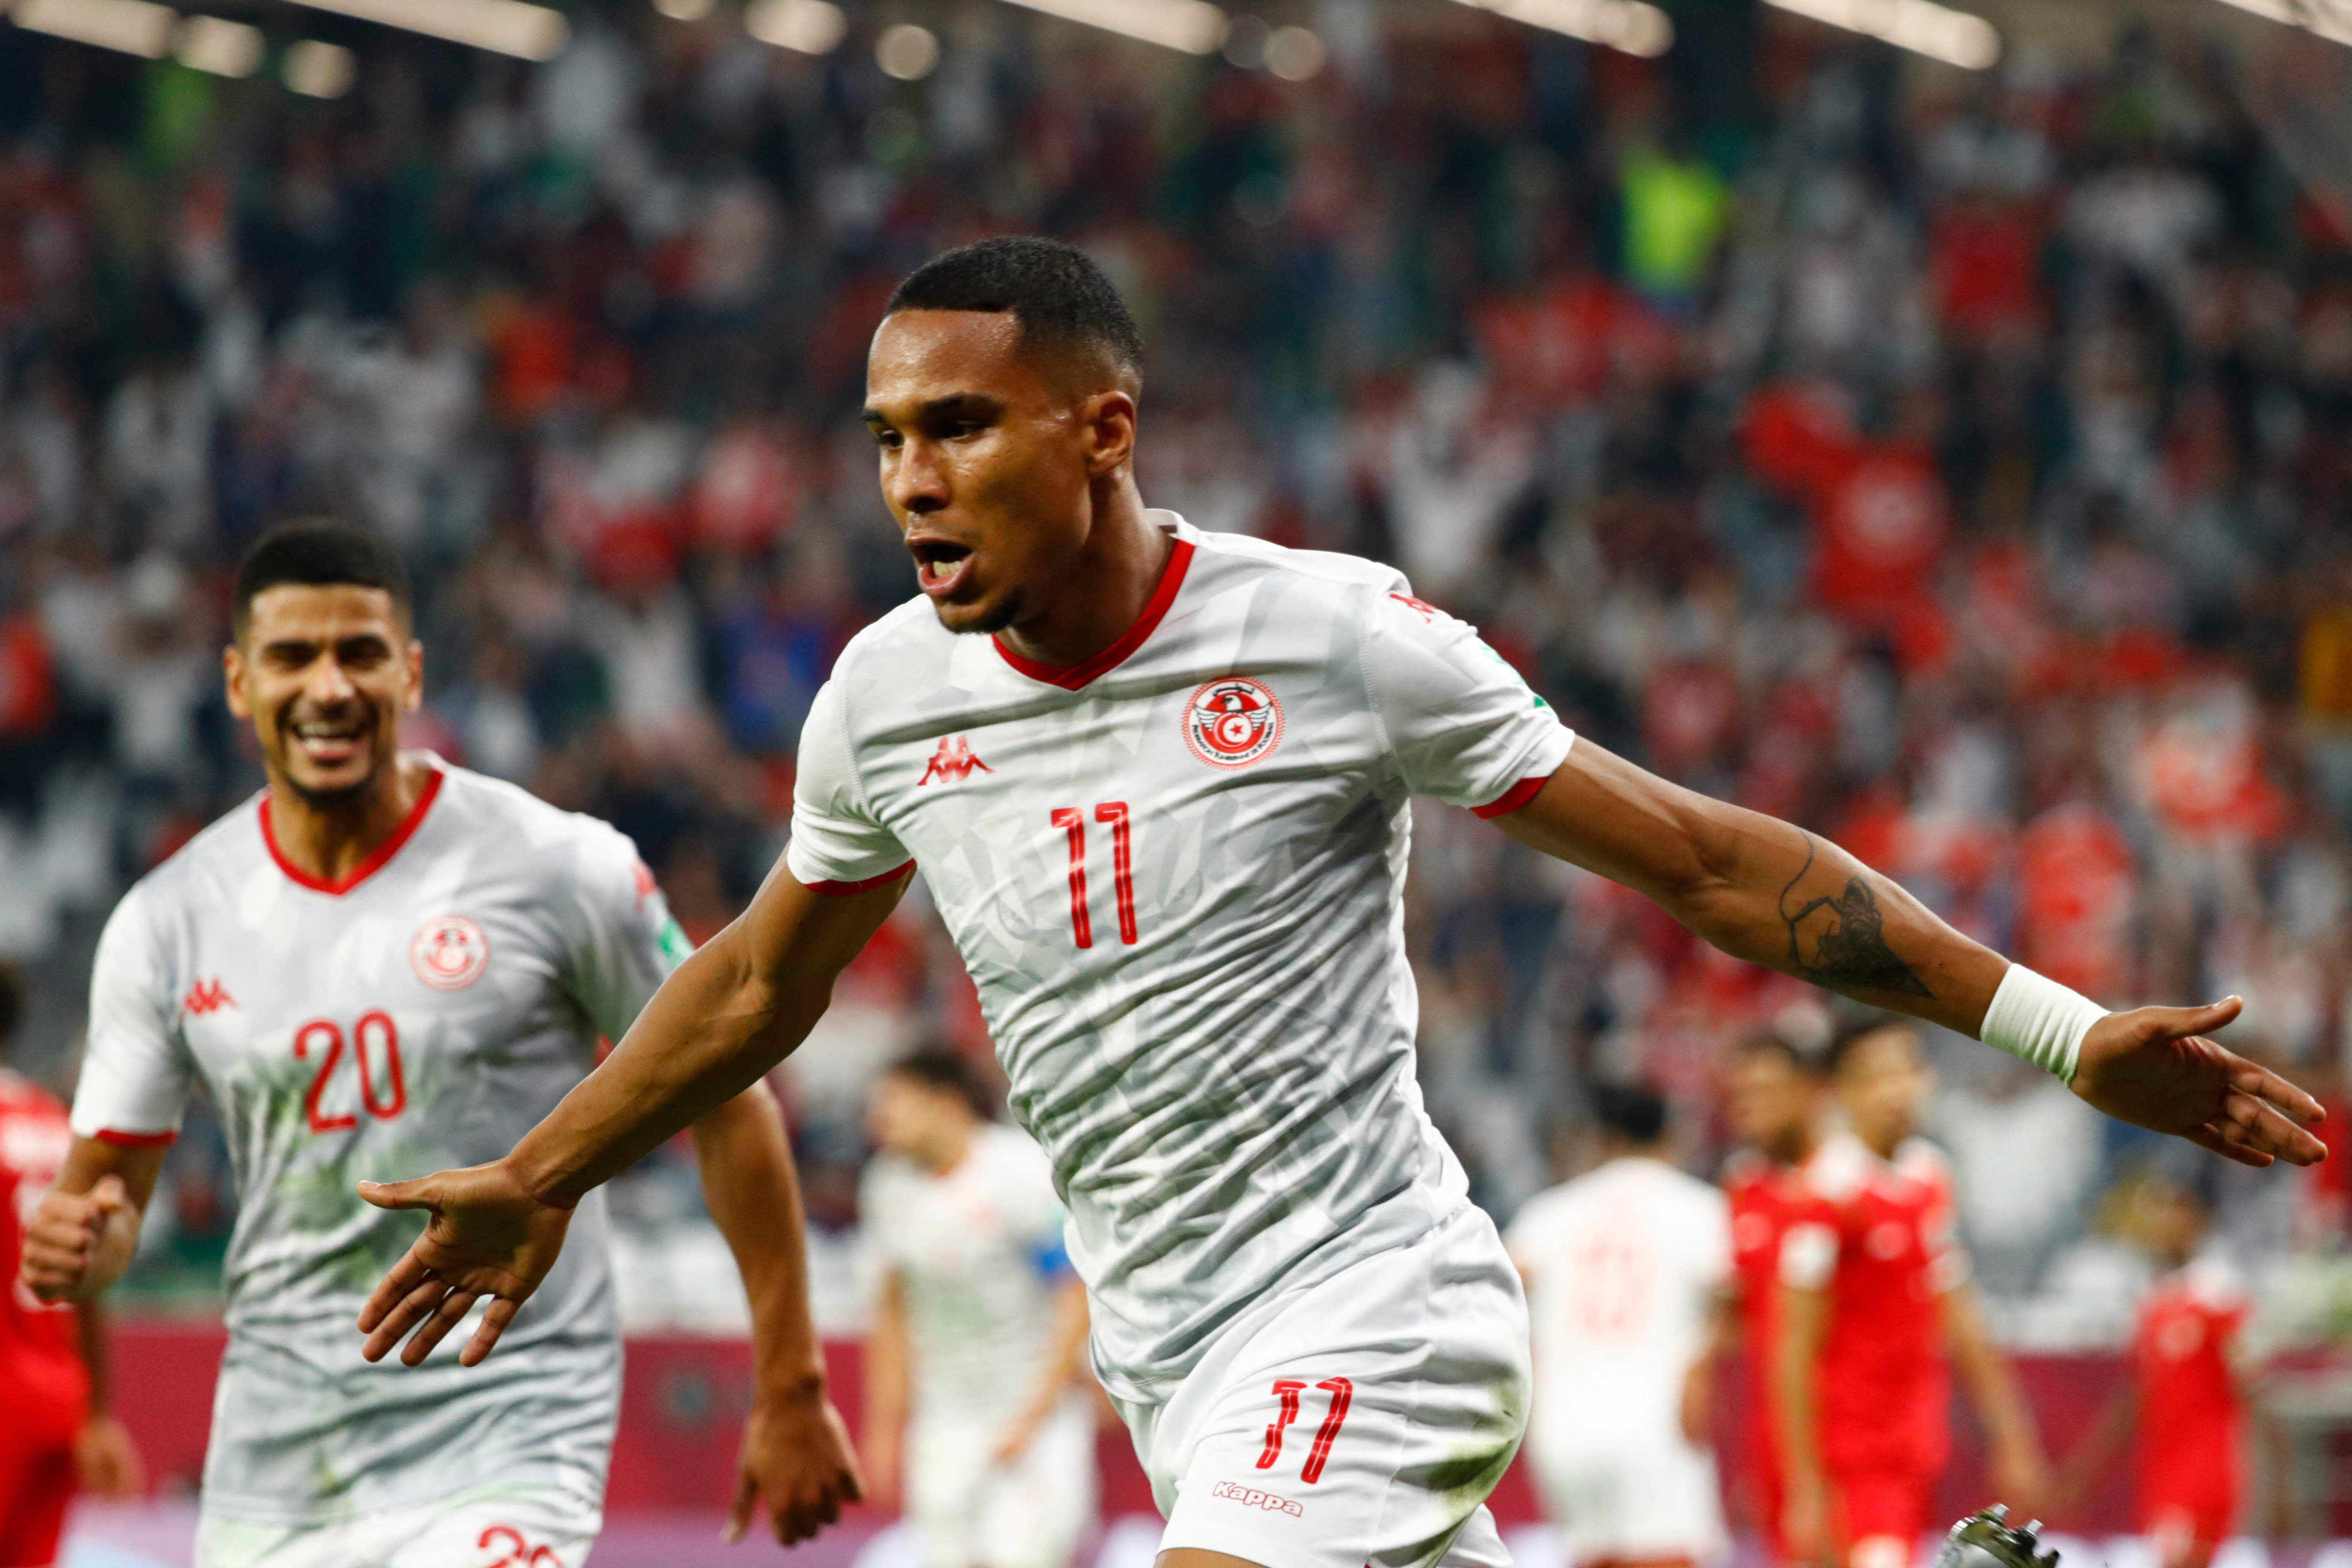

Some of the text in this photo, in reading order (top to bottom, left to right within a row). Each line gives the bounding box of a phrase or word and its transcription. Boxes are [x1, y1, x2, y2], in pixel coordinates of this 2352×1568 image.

[1050, 801, 1137, 949] 11
[294, 1010, 406, 1134] 20
[1256, 1377, 1353, 1484] 11
[1213, 1481, 1303, 1517] Kappa
